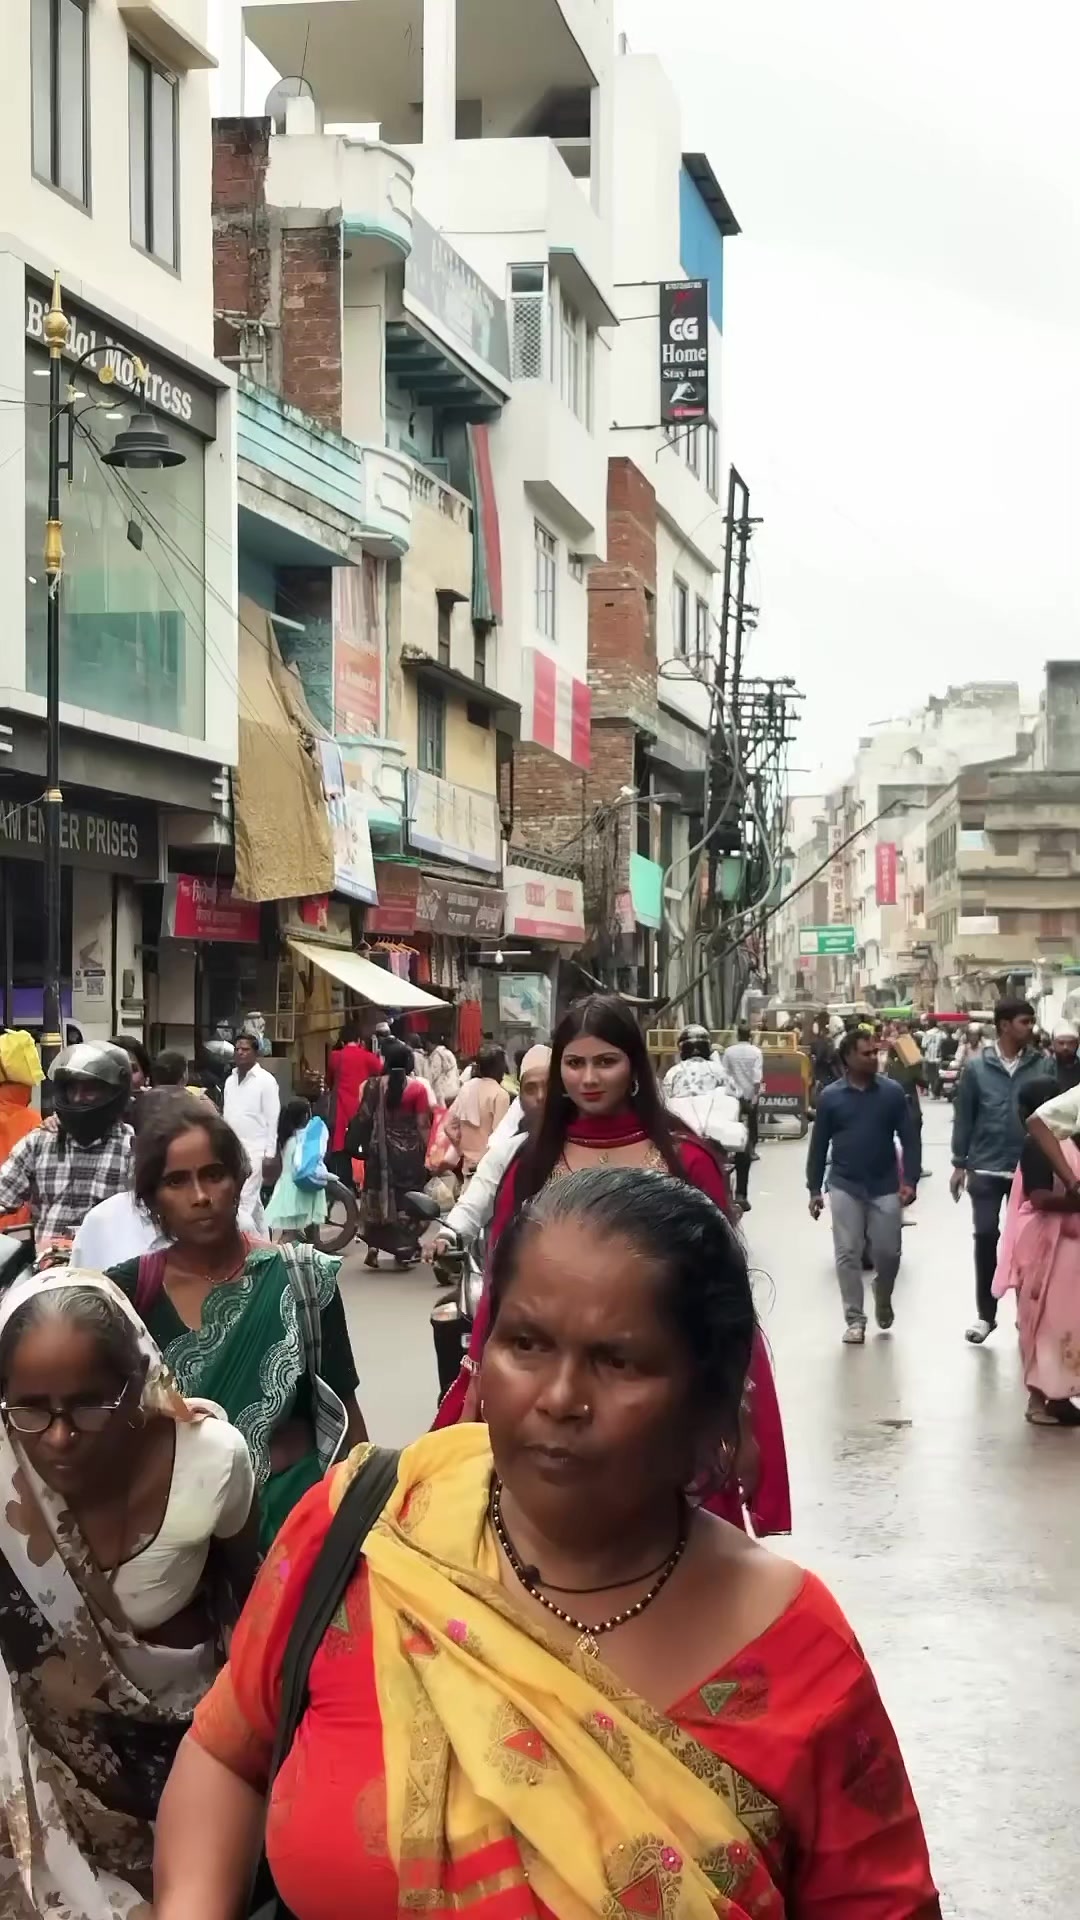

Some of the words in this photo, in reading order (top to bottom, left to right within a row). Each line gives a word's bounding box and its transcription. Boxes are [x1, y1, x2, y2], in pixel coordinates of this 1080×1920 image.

[662, 343, 707, 363] Home
[105, 336, 192, 420] Matress
[663, 367, 685, 380] Stay
[27, 804, 80, 850] ENER
[86, 815, 138, 859] PRISES
